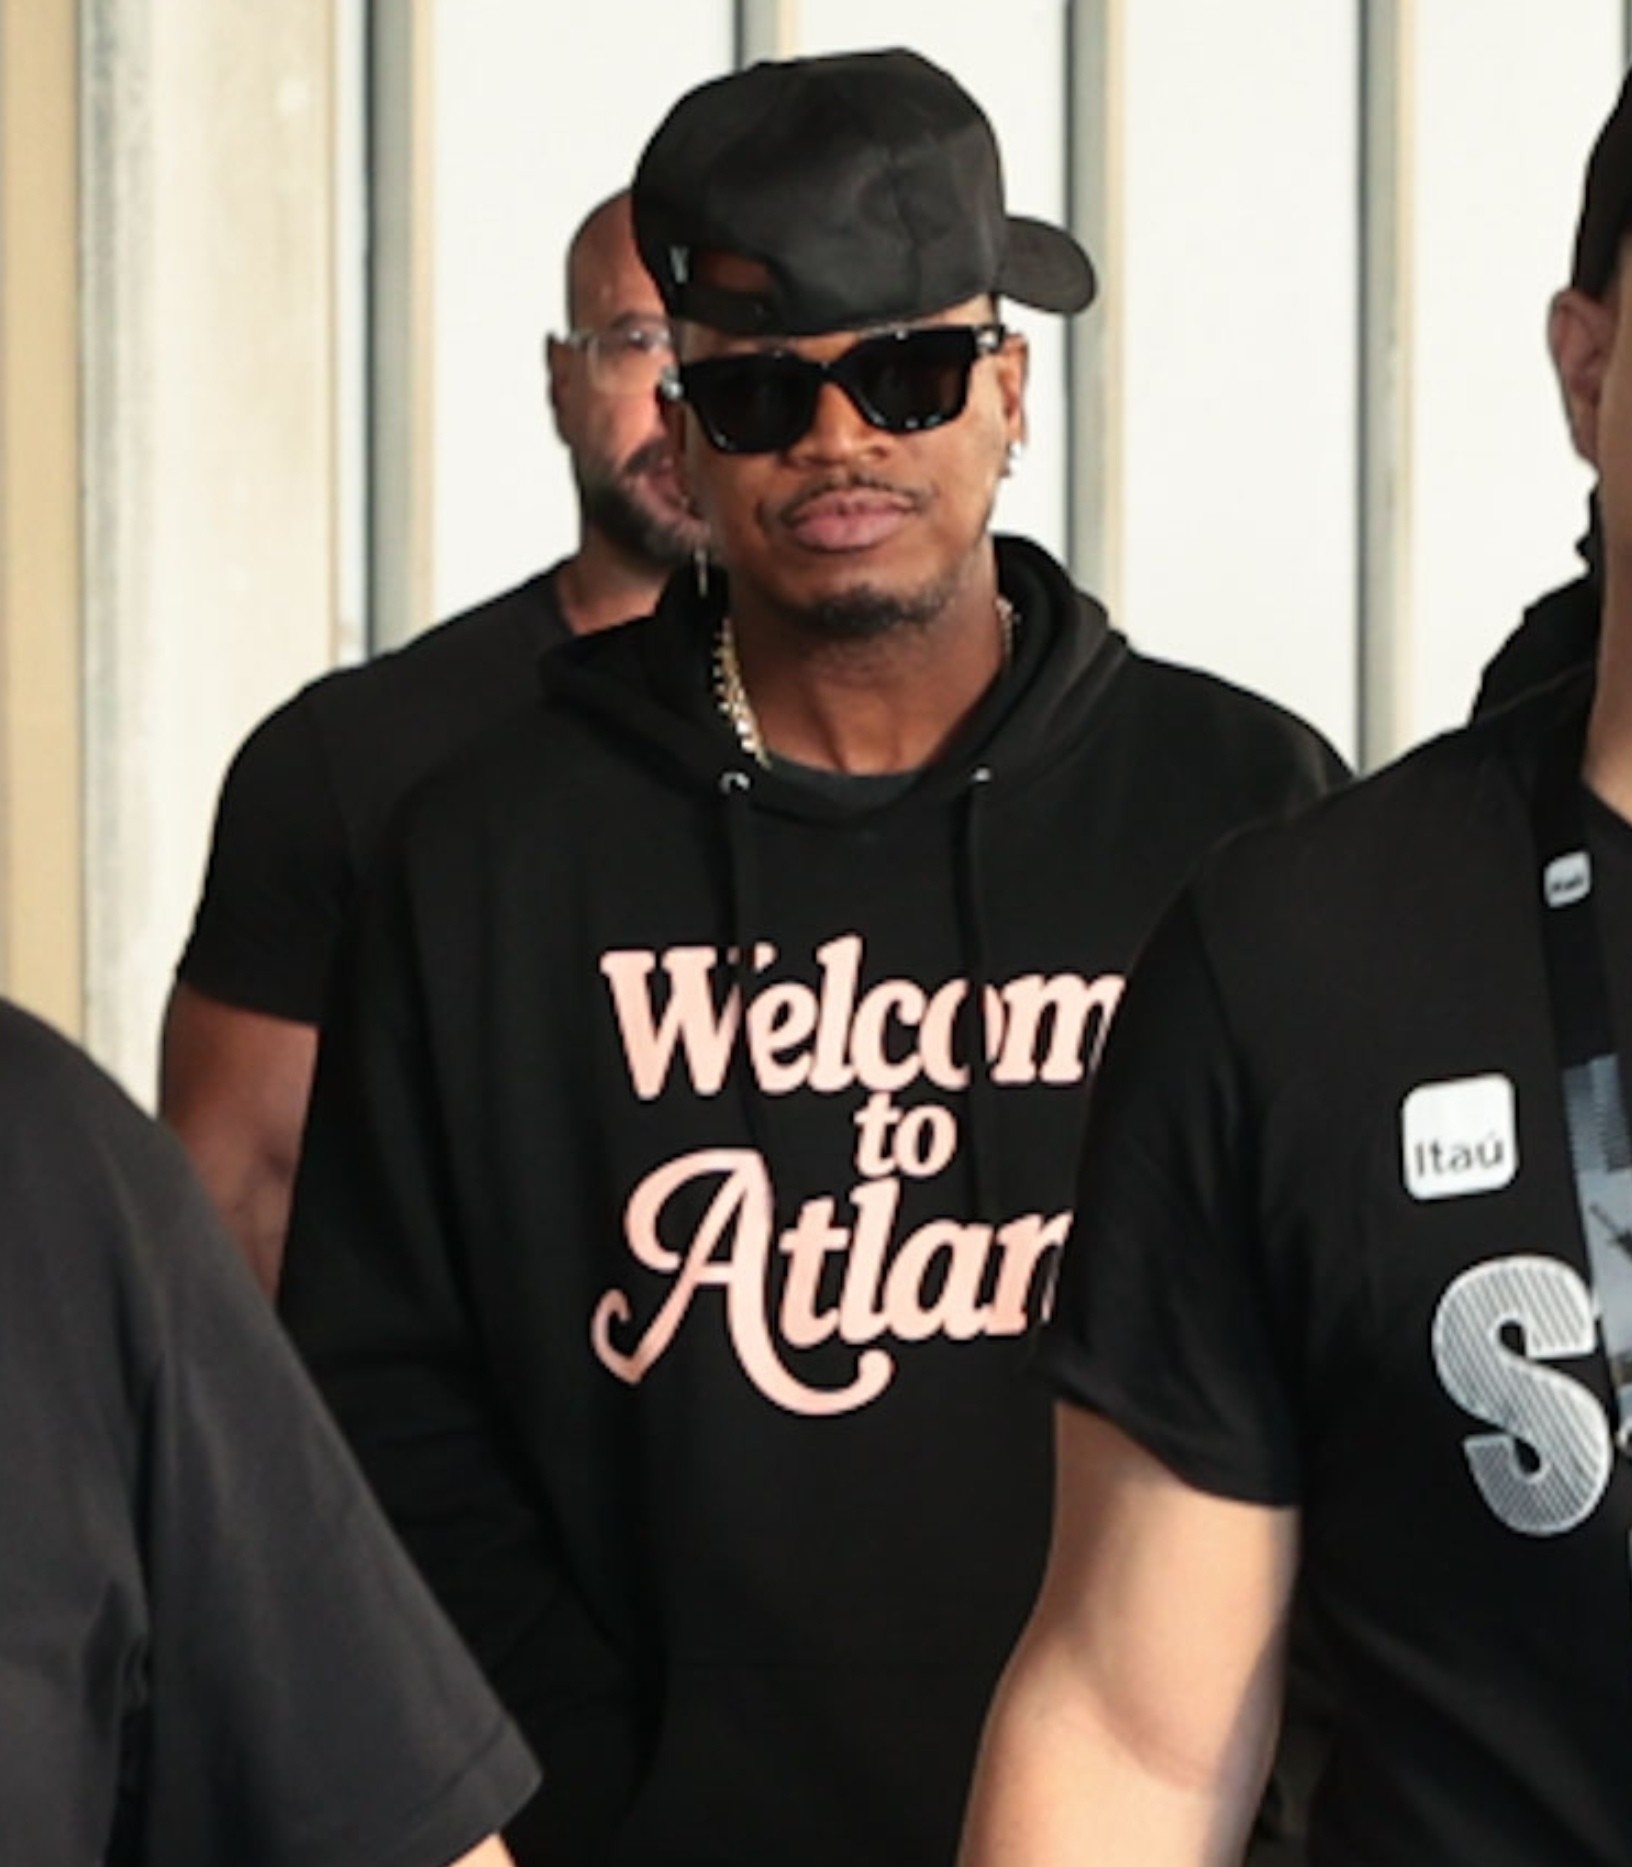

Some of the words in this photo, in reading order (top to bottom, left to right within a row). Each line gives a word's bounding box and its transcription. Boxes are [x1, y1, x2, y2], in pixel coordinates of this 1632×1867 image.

[599, 935, 1126, 1099] Welcom
[854, 1091, 958, 1178] to
[1414, 1130, 1505, 1178] Itaú
[591, 1147, 1074, 1415] Atlan
